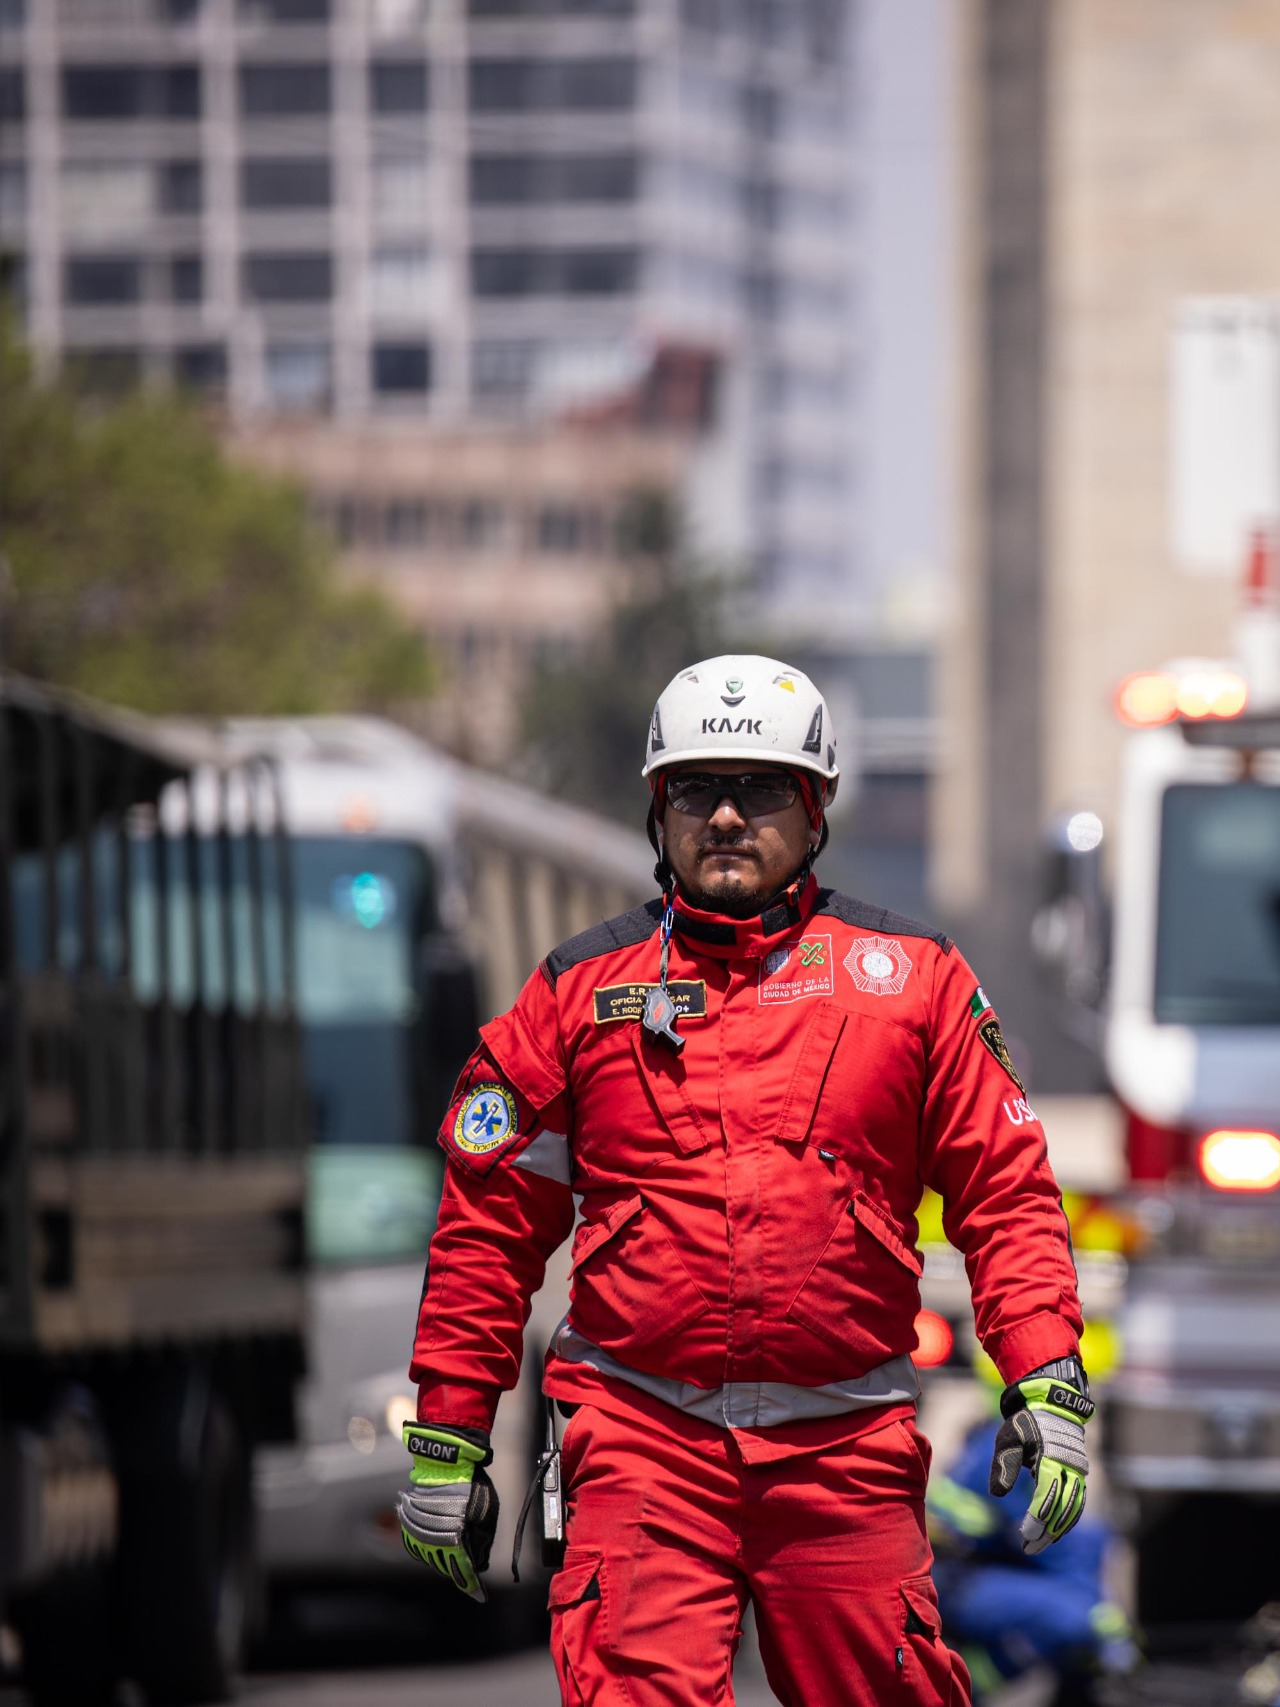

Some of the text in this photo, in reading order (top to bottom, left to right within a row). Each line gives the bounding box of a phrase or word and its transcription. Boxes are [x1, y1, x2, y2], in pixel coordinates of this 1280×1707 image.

[702, 718, 763, 735] KASK
[763, 981, 802, 991] GOBIERNO
[763, 990, 790, 998] CIUDAD
